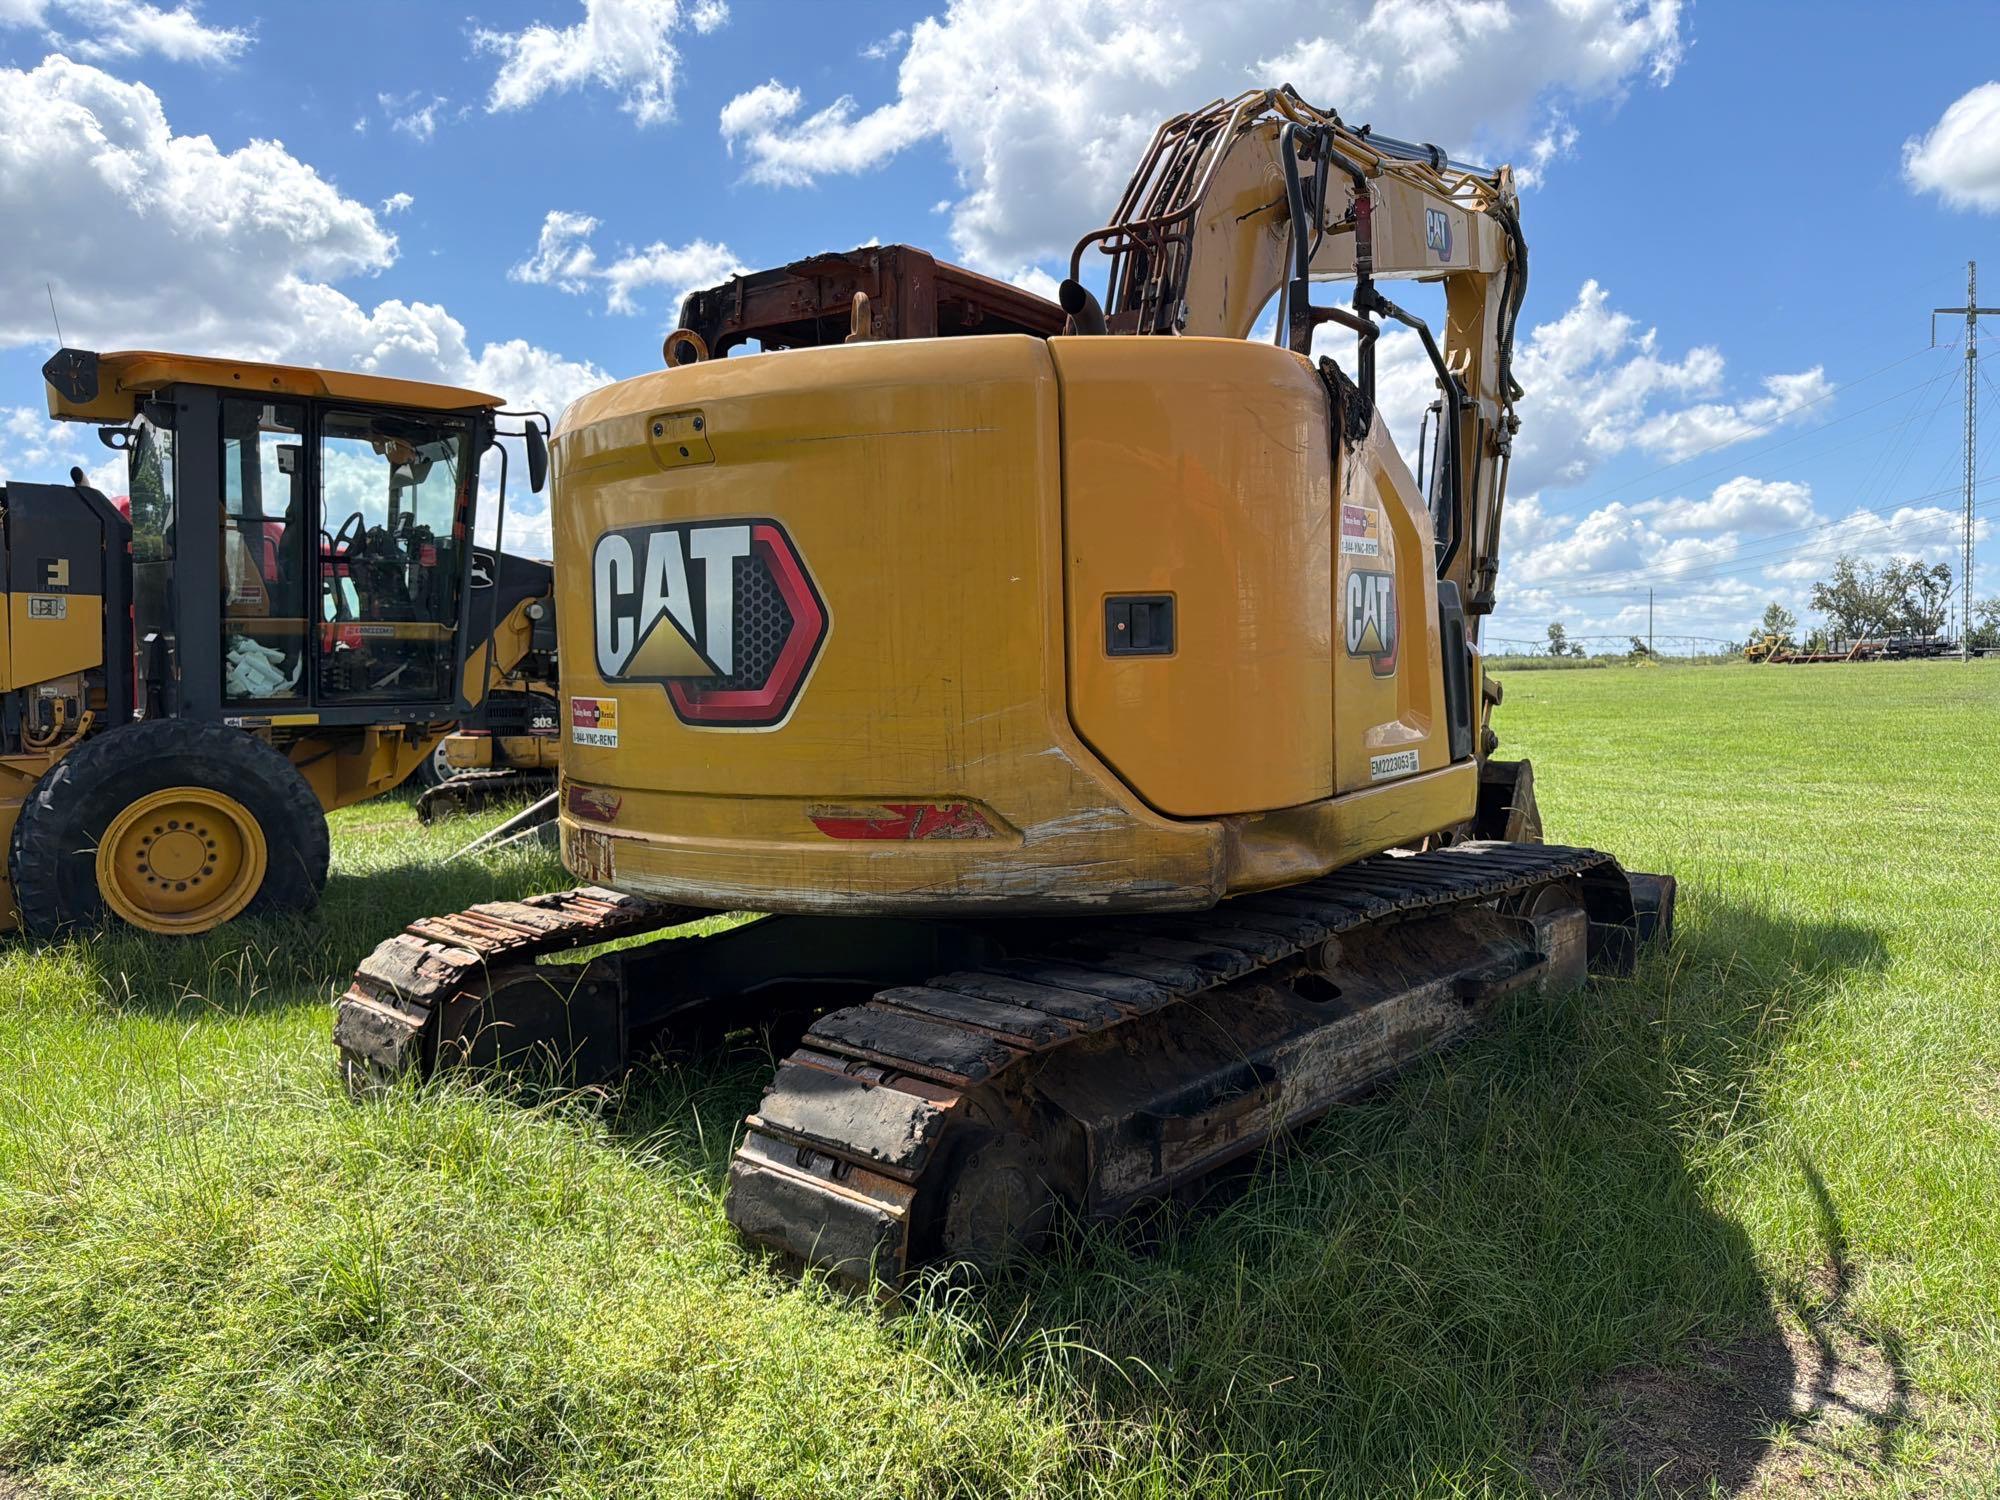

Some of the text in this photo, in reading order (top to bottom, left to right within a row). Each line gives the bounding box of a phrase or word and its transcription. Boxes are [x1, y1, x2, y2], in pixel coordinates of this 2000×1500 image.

[1426, 210, 1446, 250] CAT
[594, 525, 751, 677] CAT
[1347, 573, 1390, 653] CAT
[1371, 755, 1409, 775] EM2223053
